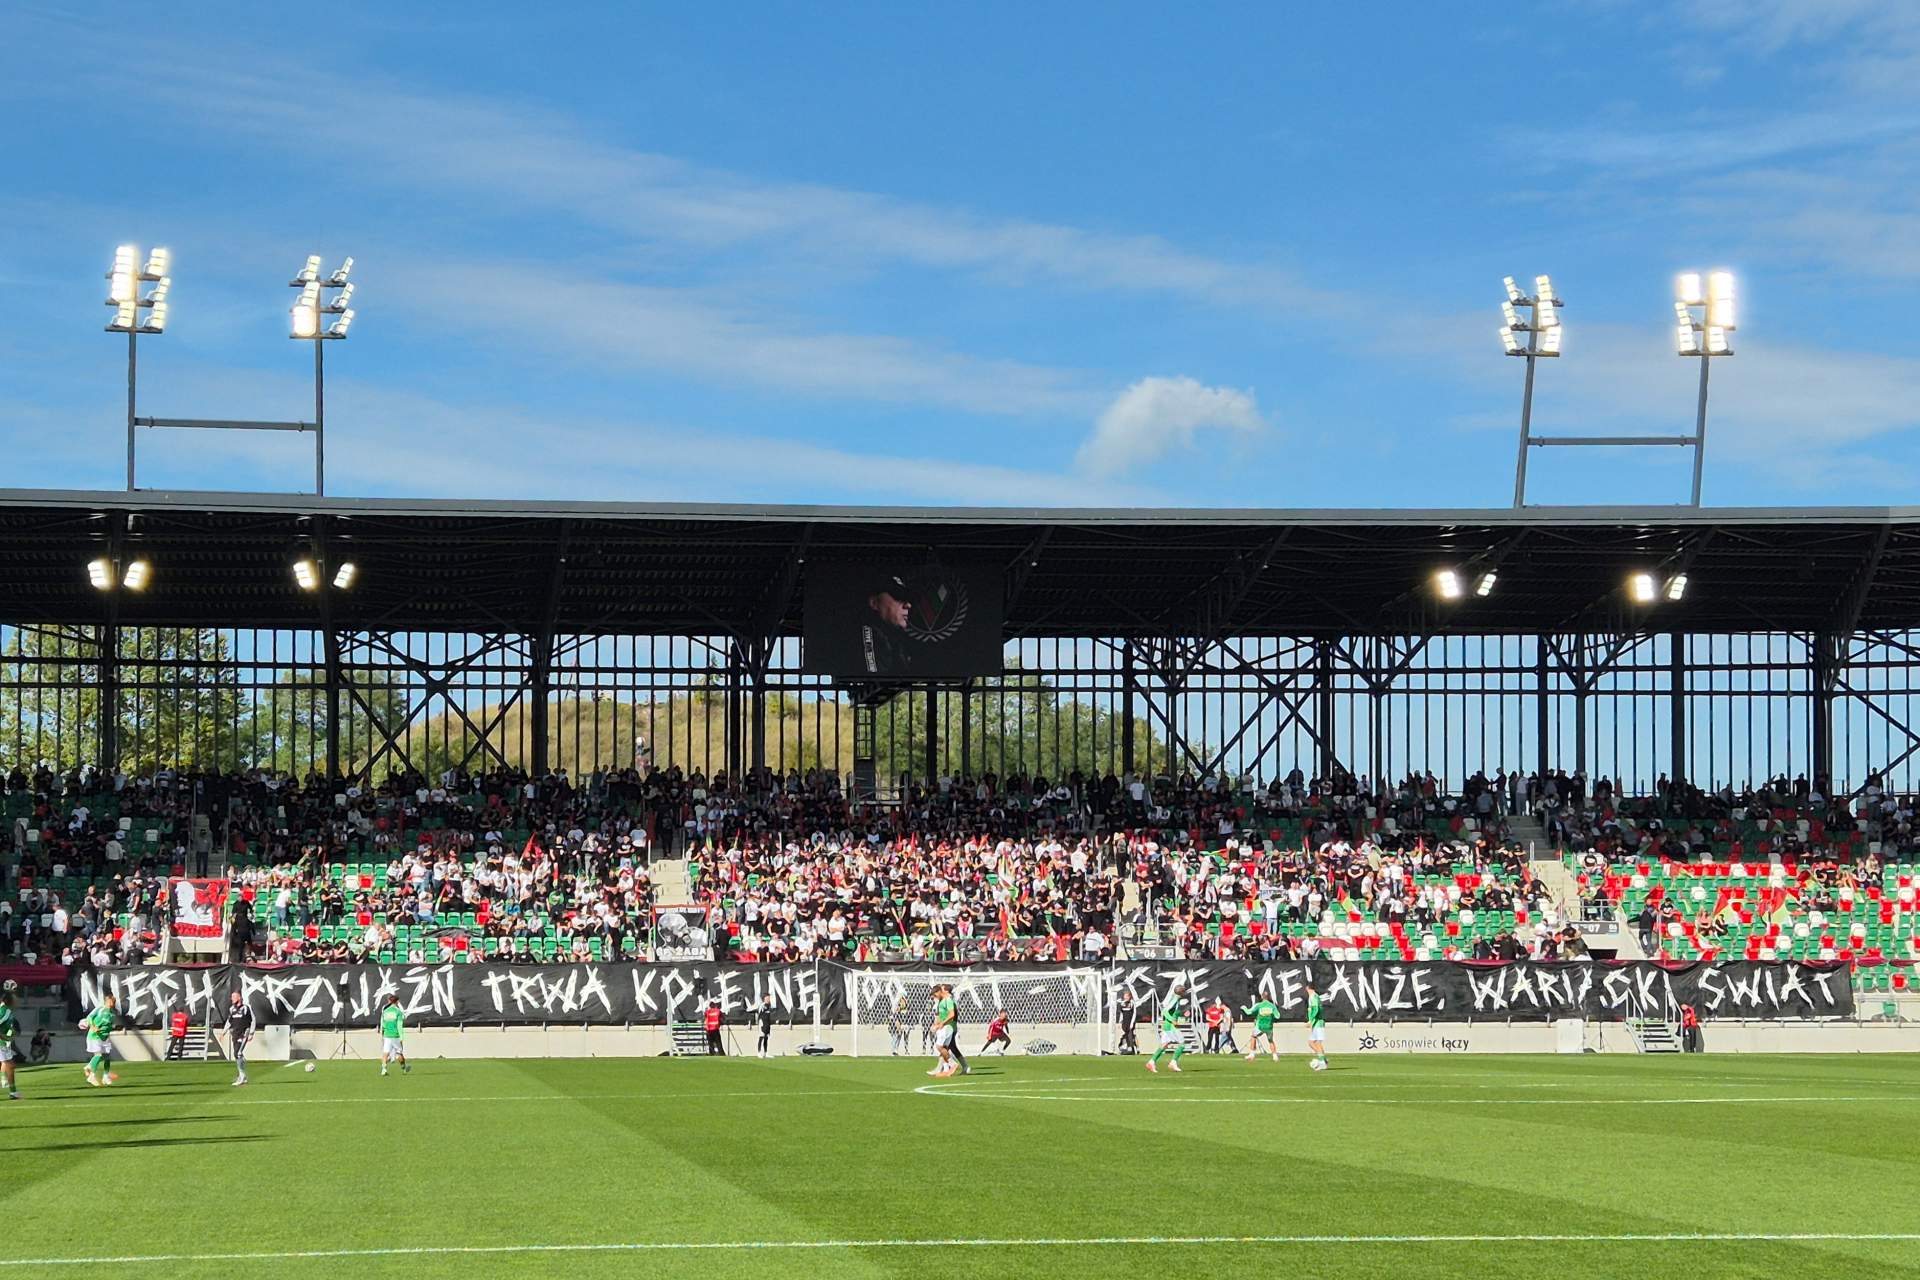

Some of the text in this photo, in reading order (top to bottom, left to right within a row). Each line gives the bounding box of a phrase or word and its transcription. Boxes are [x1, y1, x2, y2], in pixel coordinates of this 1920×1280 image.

[1588, 923, 1601, 933] 07
[1143, 948, 1157, 959] 06
[80, 969, 216, 1019] NIECH
[480, 964, 612, 1015] TRWA
[1383, 1036, 1469, 1052] Sosnowiec łączy
